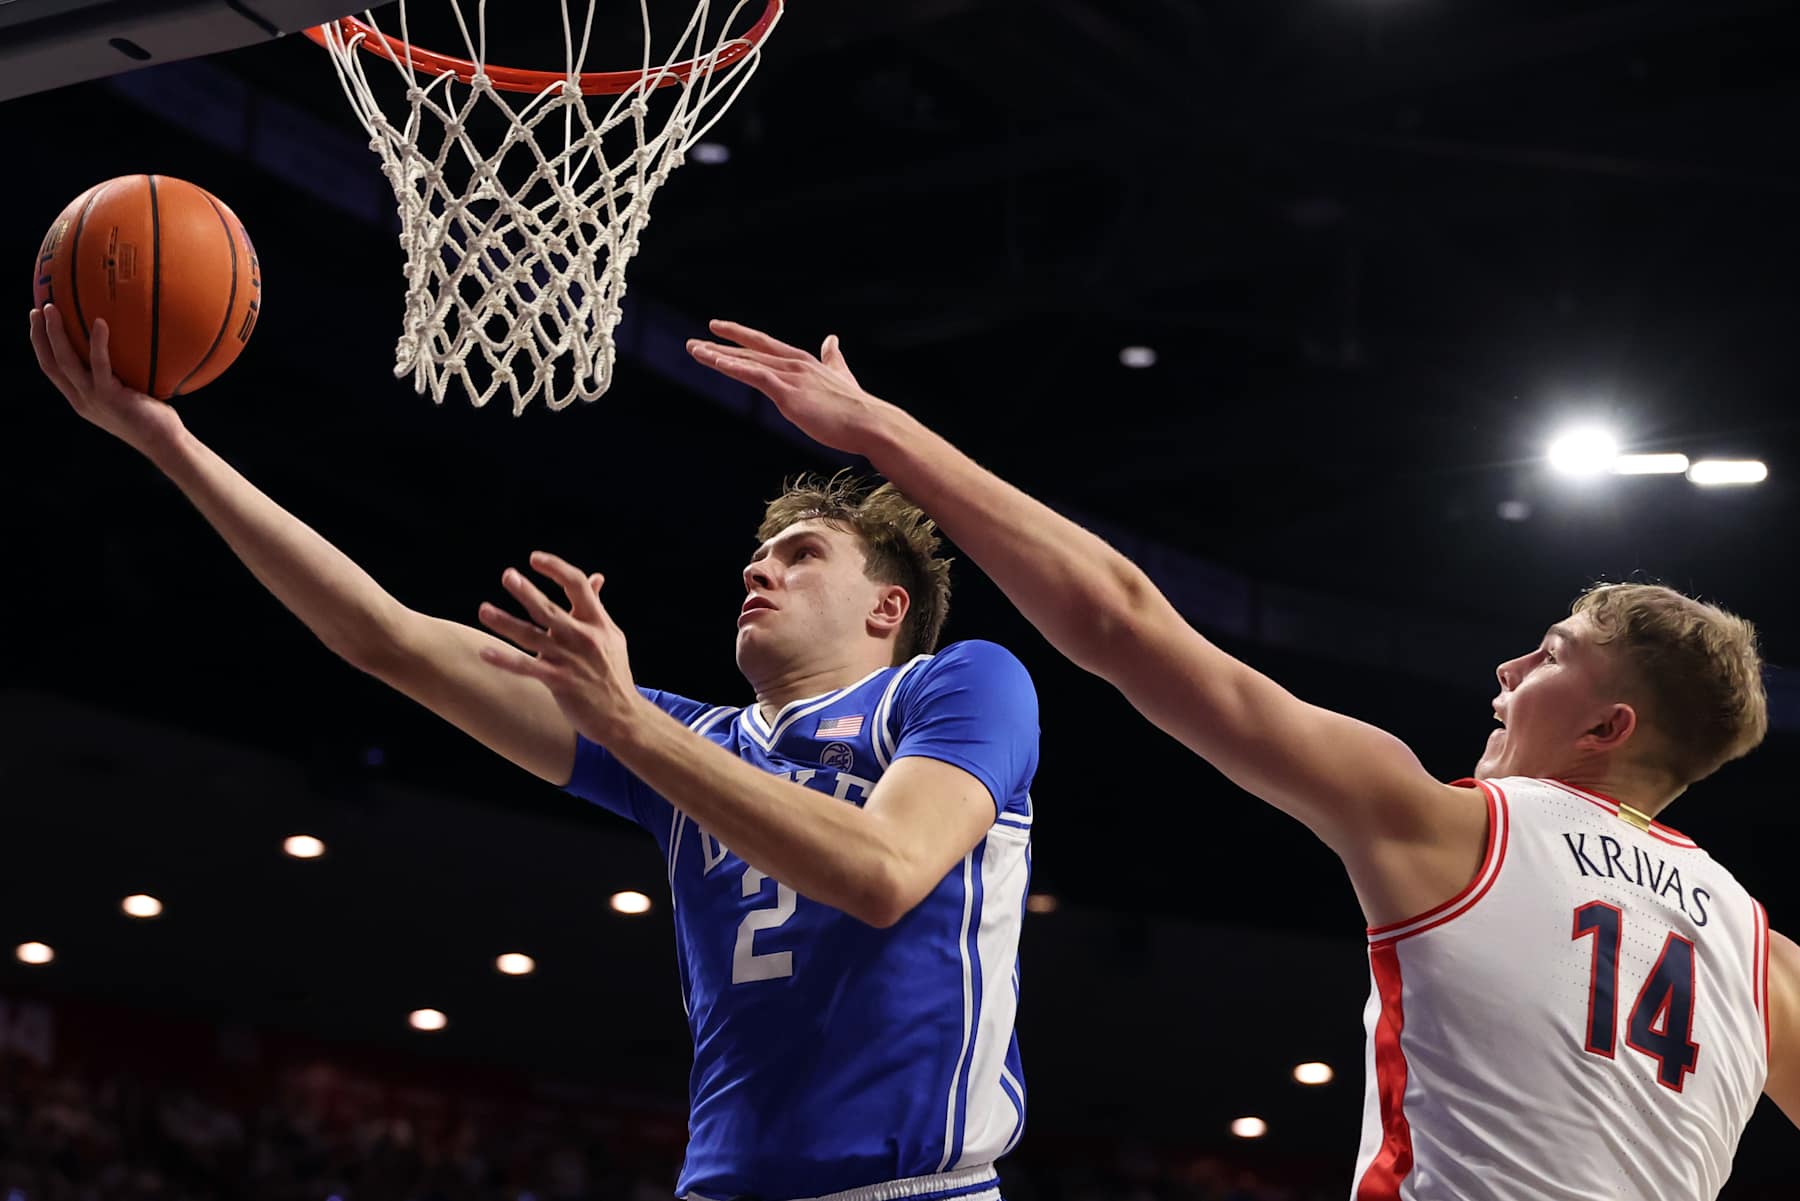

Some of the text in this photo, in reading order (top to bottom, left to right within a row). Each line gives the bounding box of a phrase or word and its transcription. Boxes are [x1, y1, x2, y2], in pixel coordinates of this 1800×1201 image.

[38, 221, 62, 305] ELIT
[698, 769, 877, 877] DE
[732, 865, 797, 985] 2
[1562, 833, 1711, 927] KRIVAS
[1572, 899, 1700, 1094] 14
